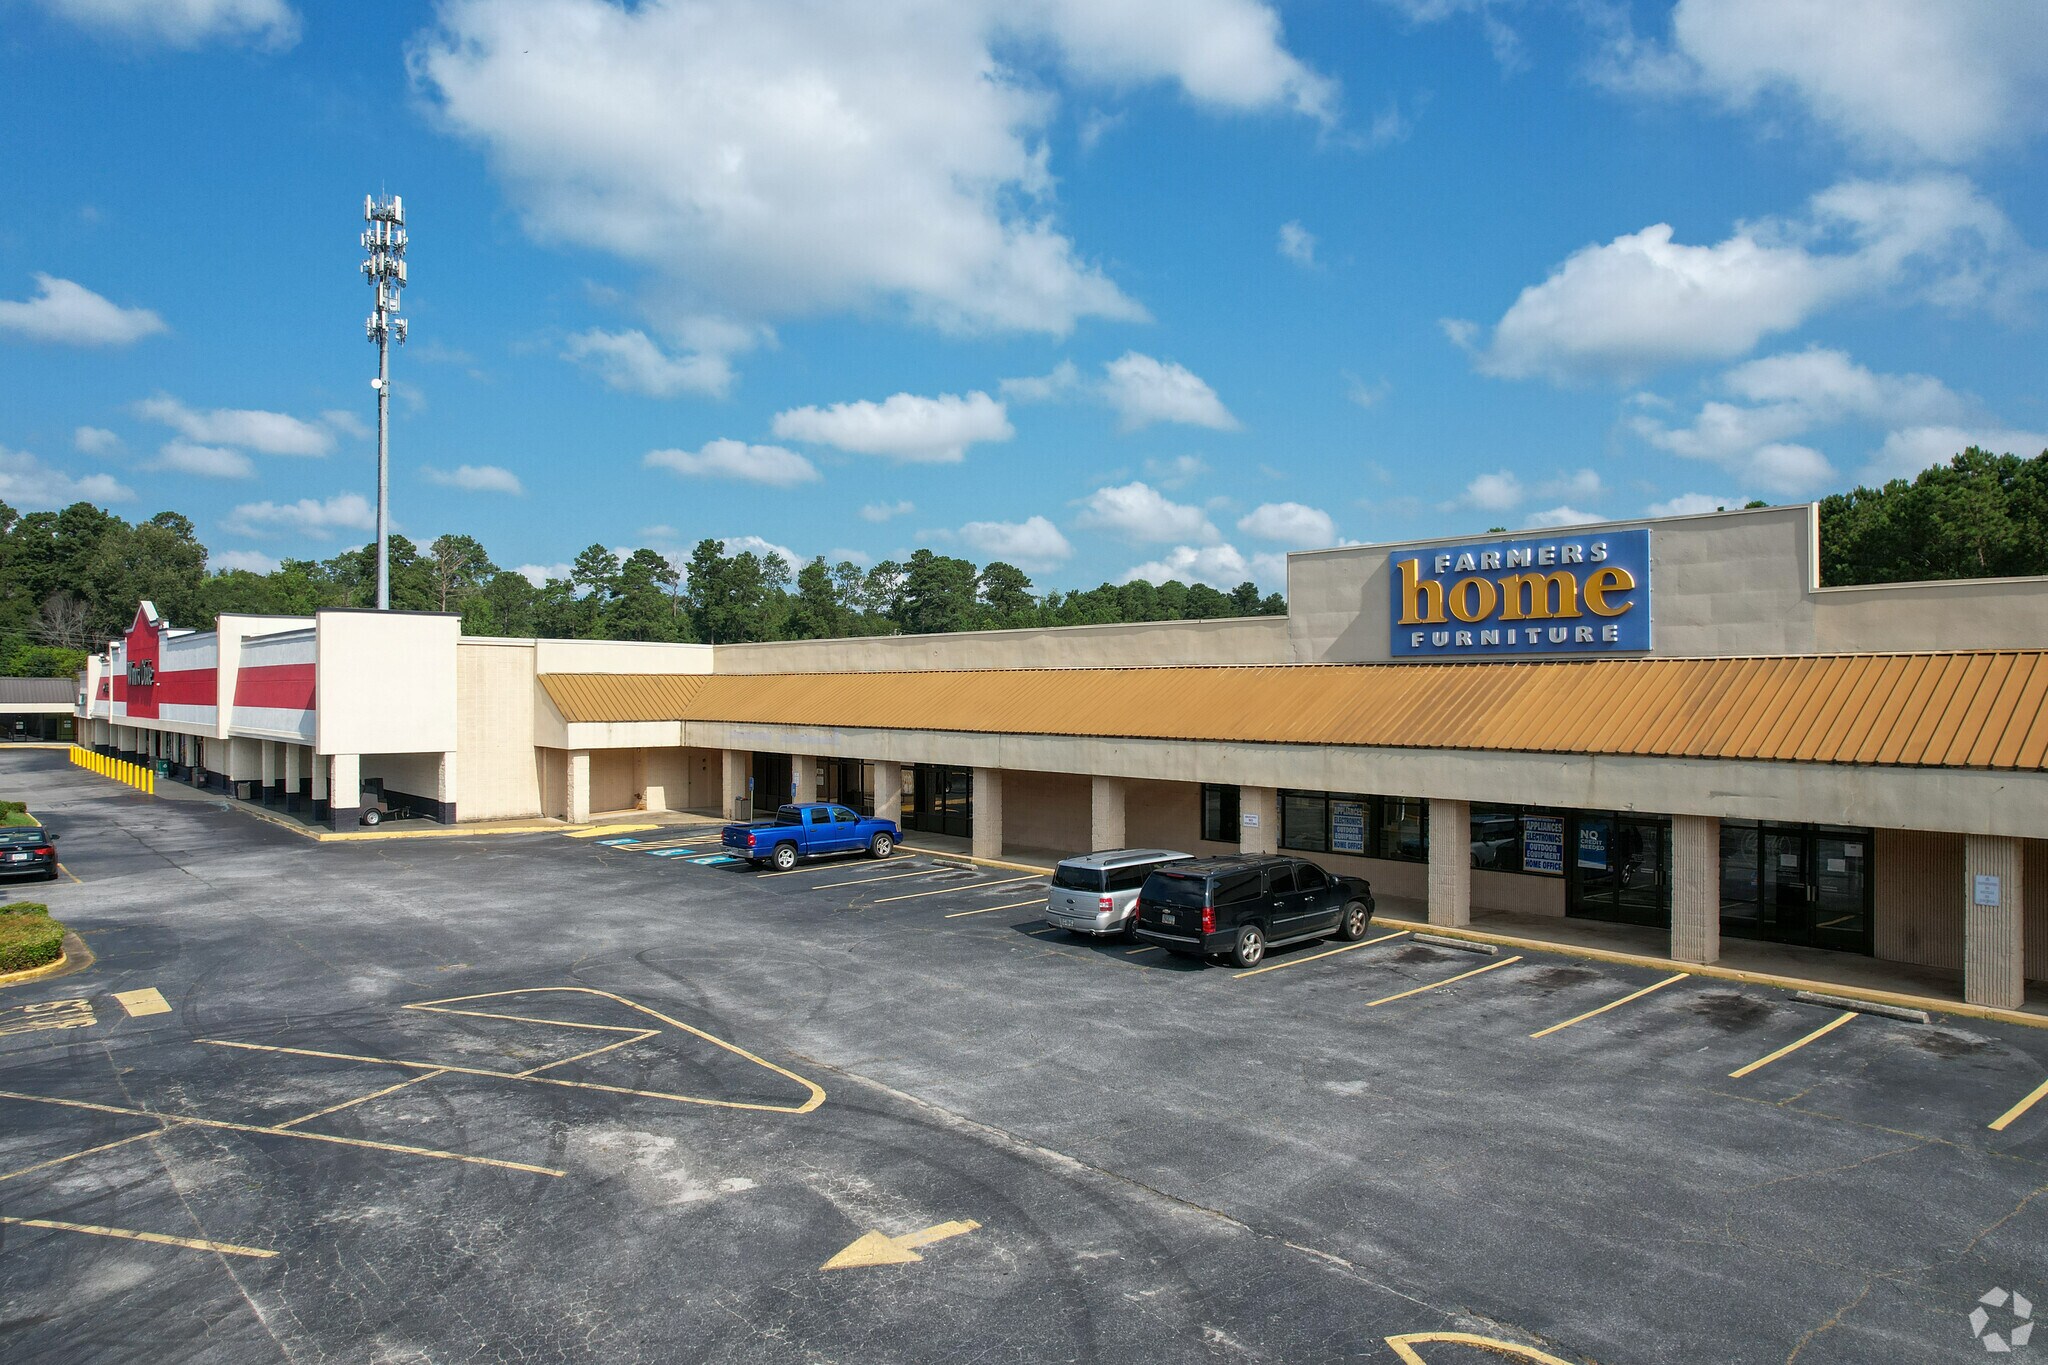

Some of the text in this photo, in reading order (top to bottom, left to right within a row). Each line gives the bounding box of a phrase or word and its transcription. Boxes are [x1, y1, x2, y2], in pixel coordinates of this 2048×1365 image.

[1435, 542, 1607, 574] FARMERS
[1397, 558, 1635, 625] home
[1411, 624, 1618, 648] FURNITURE
[1334, 807, 1362, 816] APPLIANCES
[1334, 817, 1362, 825] ELECTRONICS
[1526, 821, 1563, 833] APPLIANCES
[1526, 832, 1562, 843] ELECTRONICS
[1580, 830, 1598, 840] NO
[1334, 841, 1363, 850] HOME OFFICE
[1529, 843, 1558, 852] OUTDOOR
[1526, 850, 1561, 860] EQUIPMENT
[1525, 859, 1562, 871] HOME OFFICE
